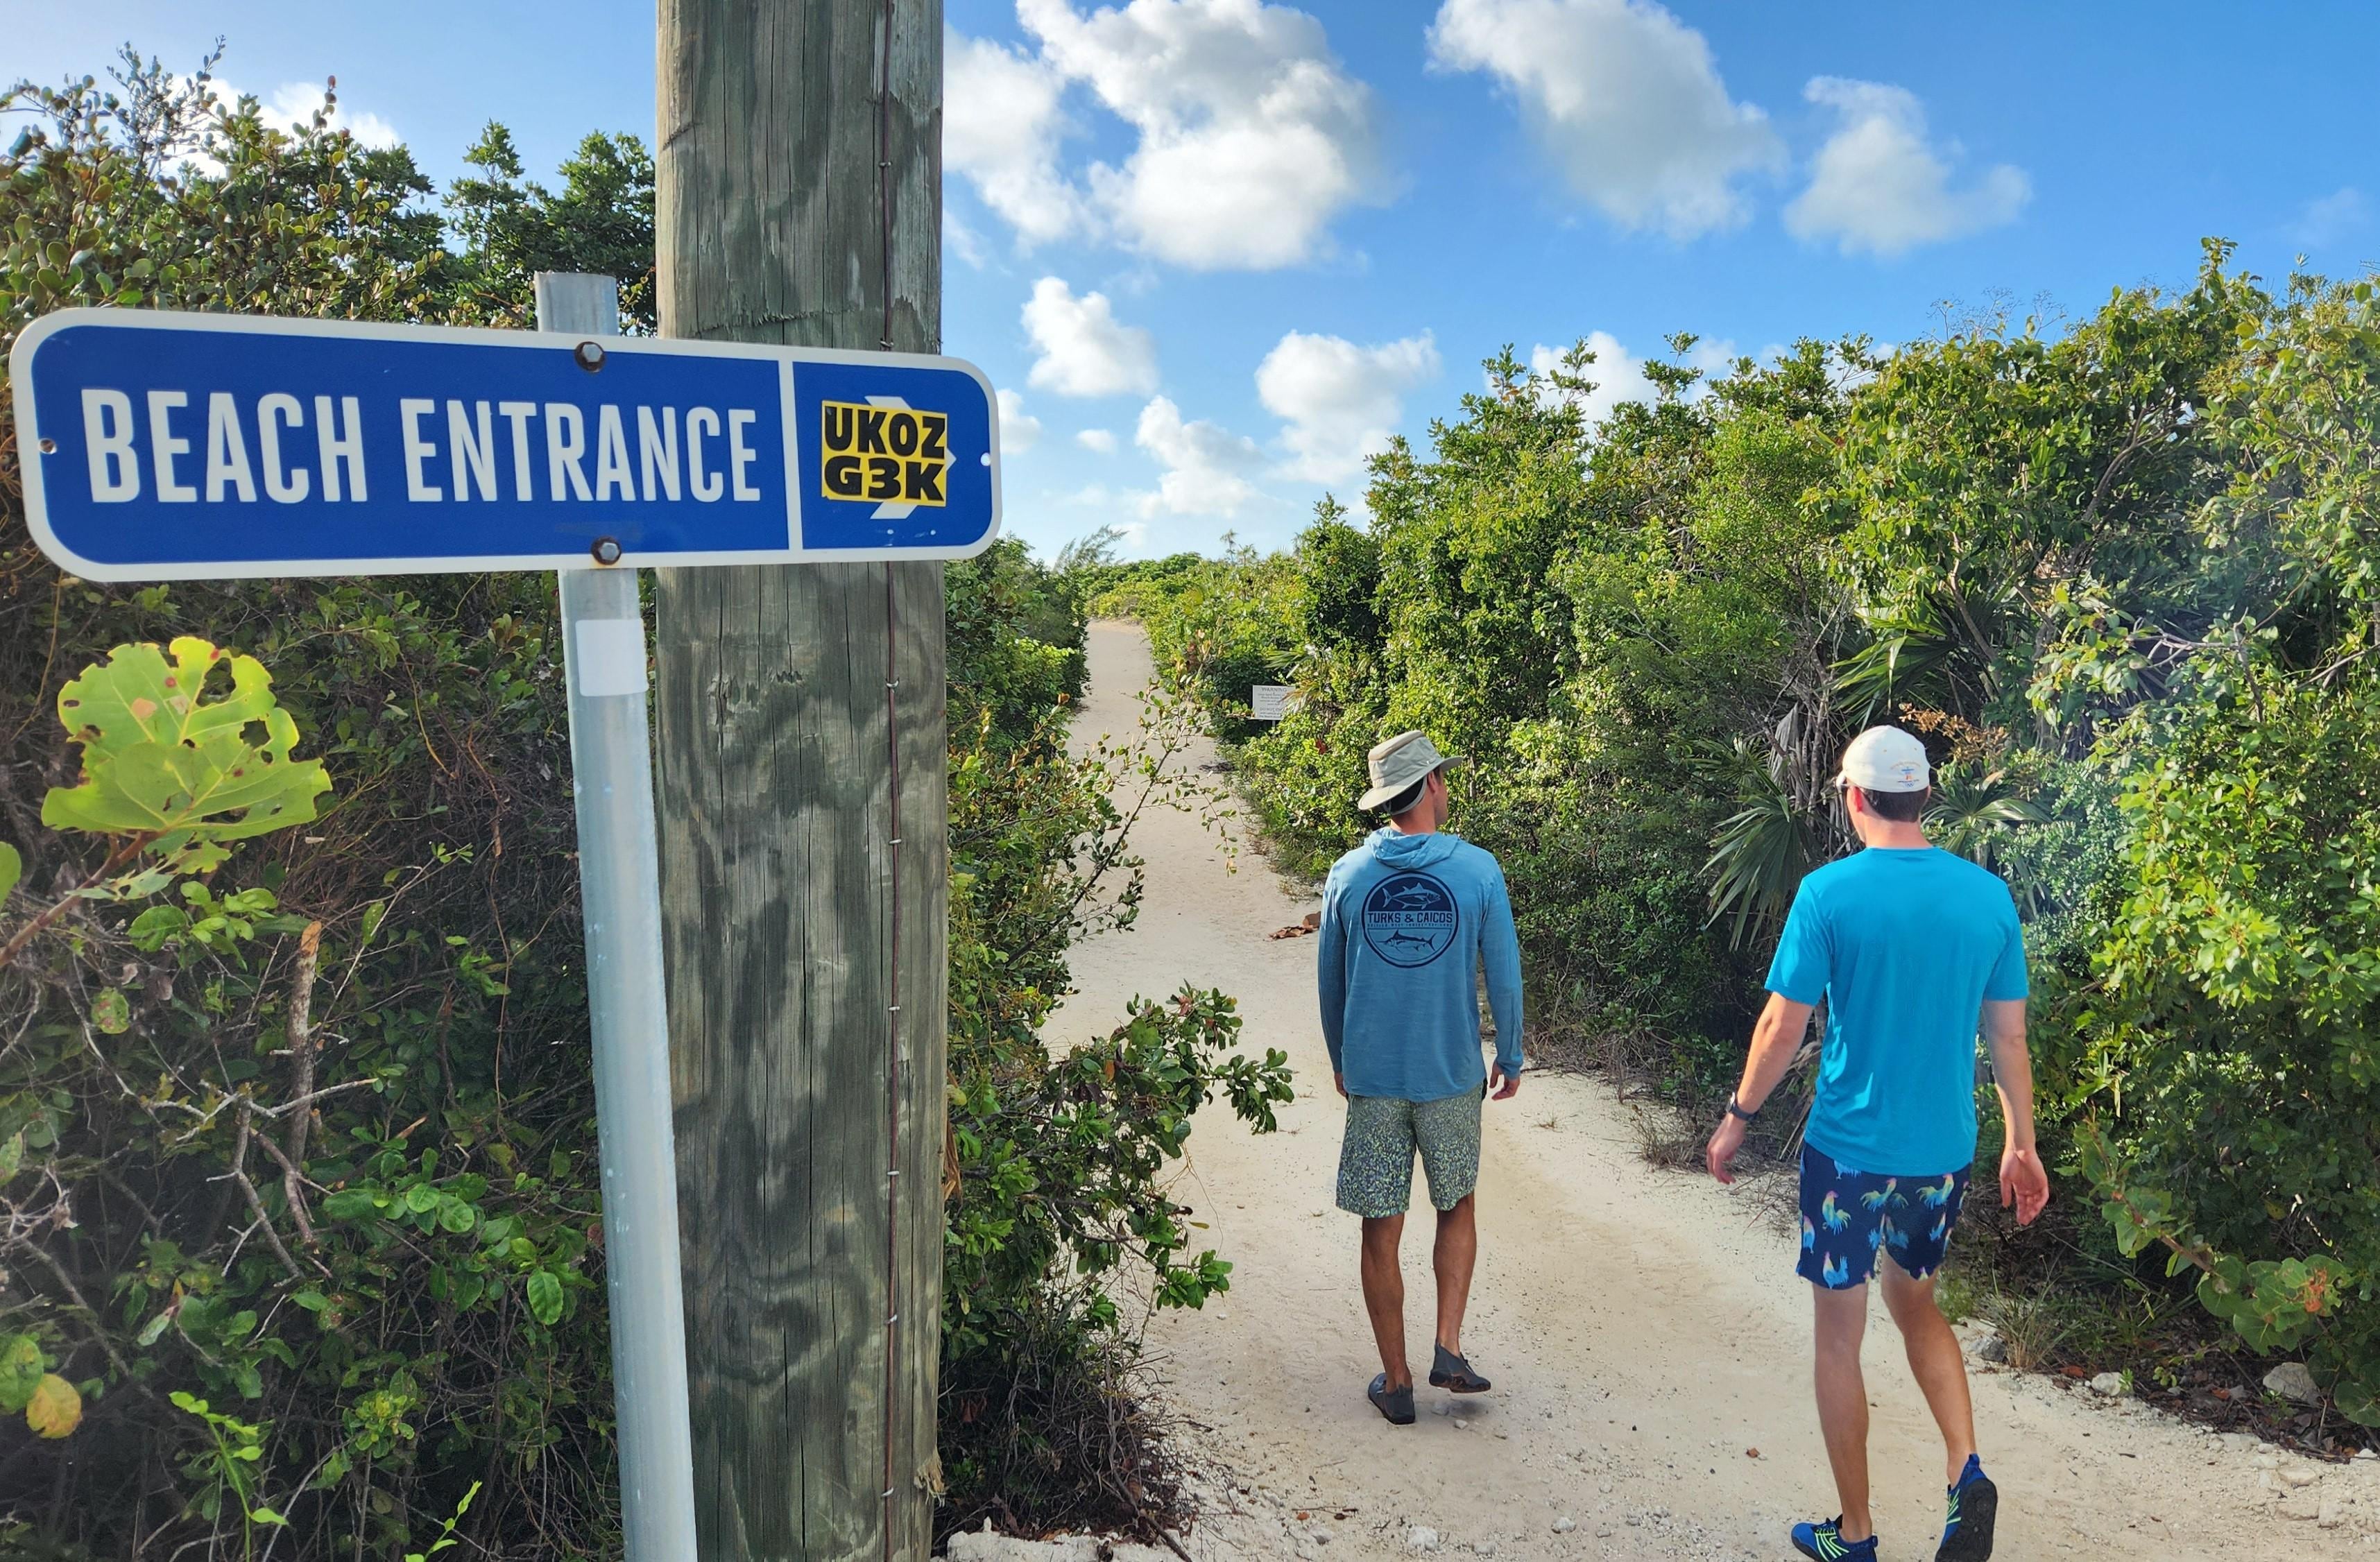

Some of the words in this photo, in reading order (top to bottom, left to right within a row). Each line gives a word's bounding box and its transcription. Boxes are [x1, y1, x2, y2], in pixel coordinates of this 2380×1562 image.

[81, 388, 368, 503] BEACH
[400, 398, 760, 502] ENTRANCE
[824, 455, 944, 501] G3K
[1367, 912, 1401, 923] TURKS
[1405, 913, 1414, 923] &
[1417, 912, 1453, 923] CAICOS
